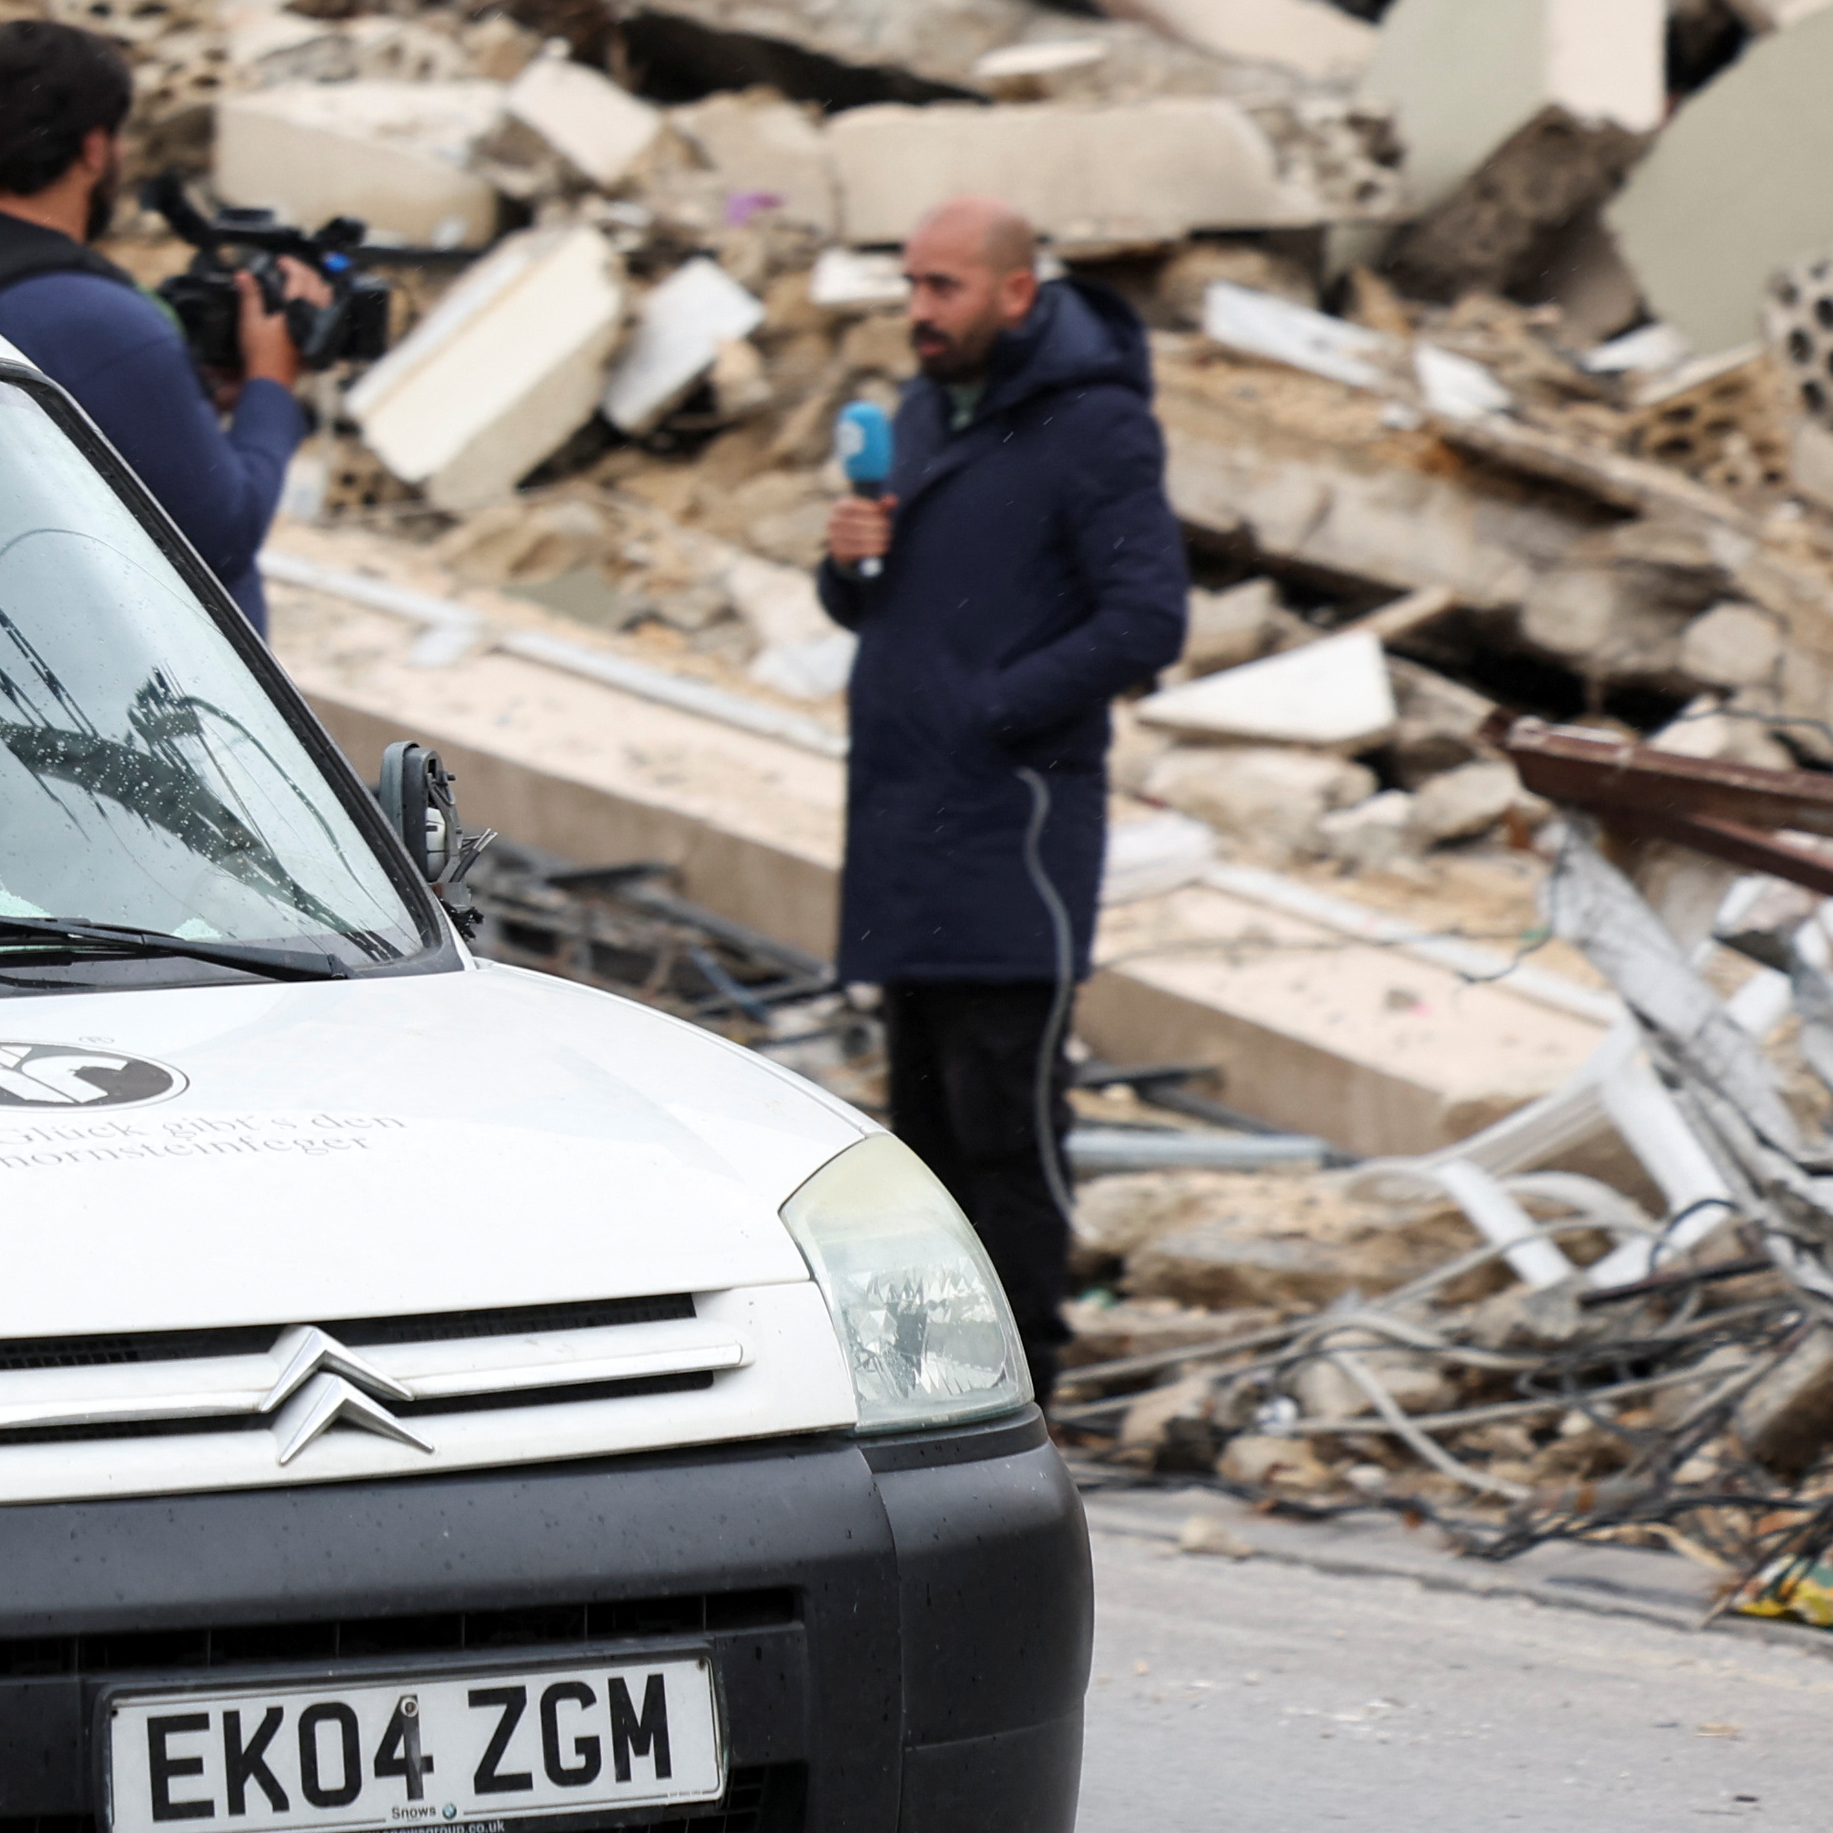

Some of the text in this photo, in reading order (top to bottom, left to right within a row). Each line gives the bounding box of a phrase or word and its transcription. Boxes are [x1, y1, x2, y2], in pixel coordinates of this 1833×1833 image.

[311, 1114, 406, 1130] den
[146, 1672, 673, 1822] EK04 ZGM
[391, 1805, 437, 1820] Snows
